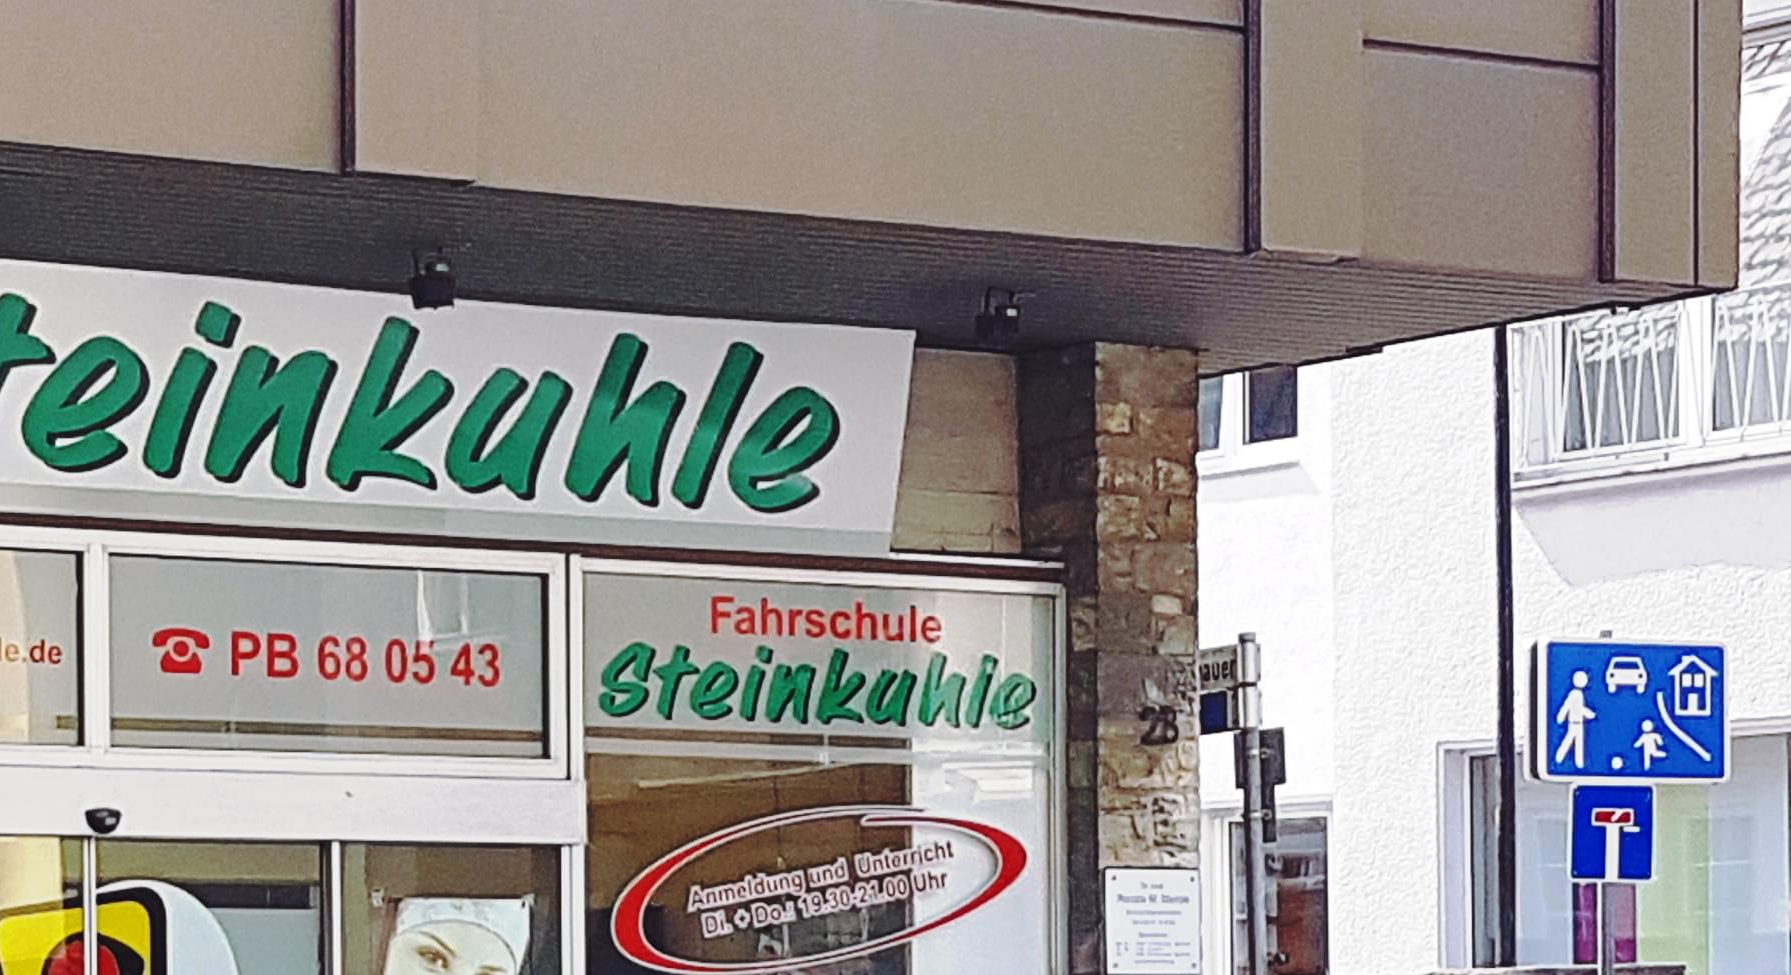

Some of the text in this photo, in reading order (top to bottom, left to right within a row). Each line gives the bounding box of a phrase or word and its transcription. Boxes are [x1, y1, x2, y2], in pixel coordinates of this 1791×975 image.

[709, 596, 942, 643] Fahrschule
[231, 630, 501, 688] PB 68 05 43
[598, 641, 1037, 731] Steinkuhle
[690, 841, 954, 906] Anmeldung und Unterricht
[800, 879, 907, 914] 19.30-21.00
[914, 871, 948, 893] Uhr
